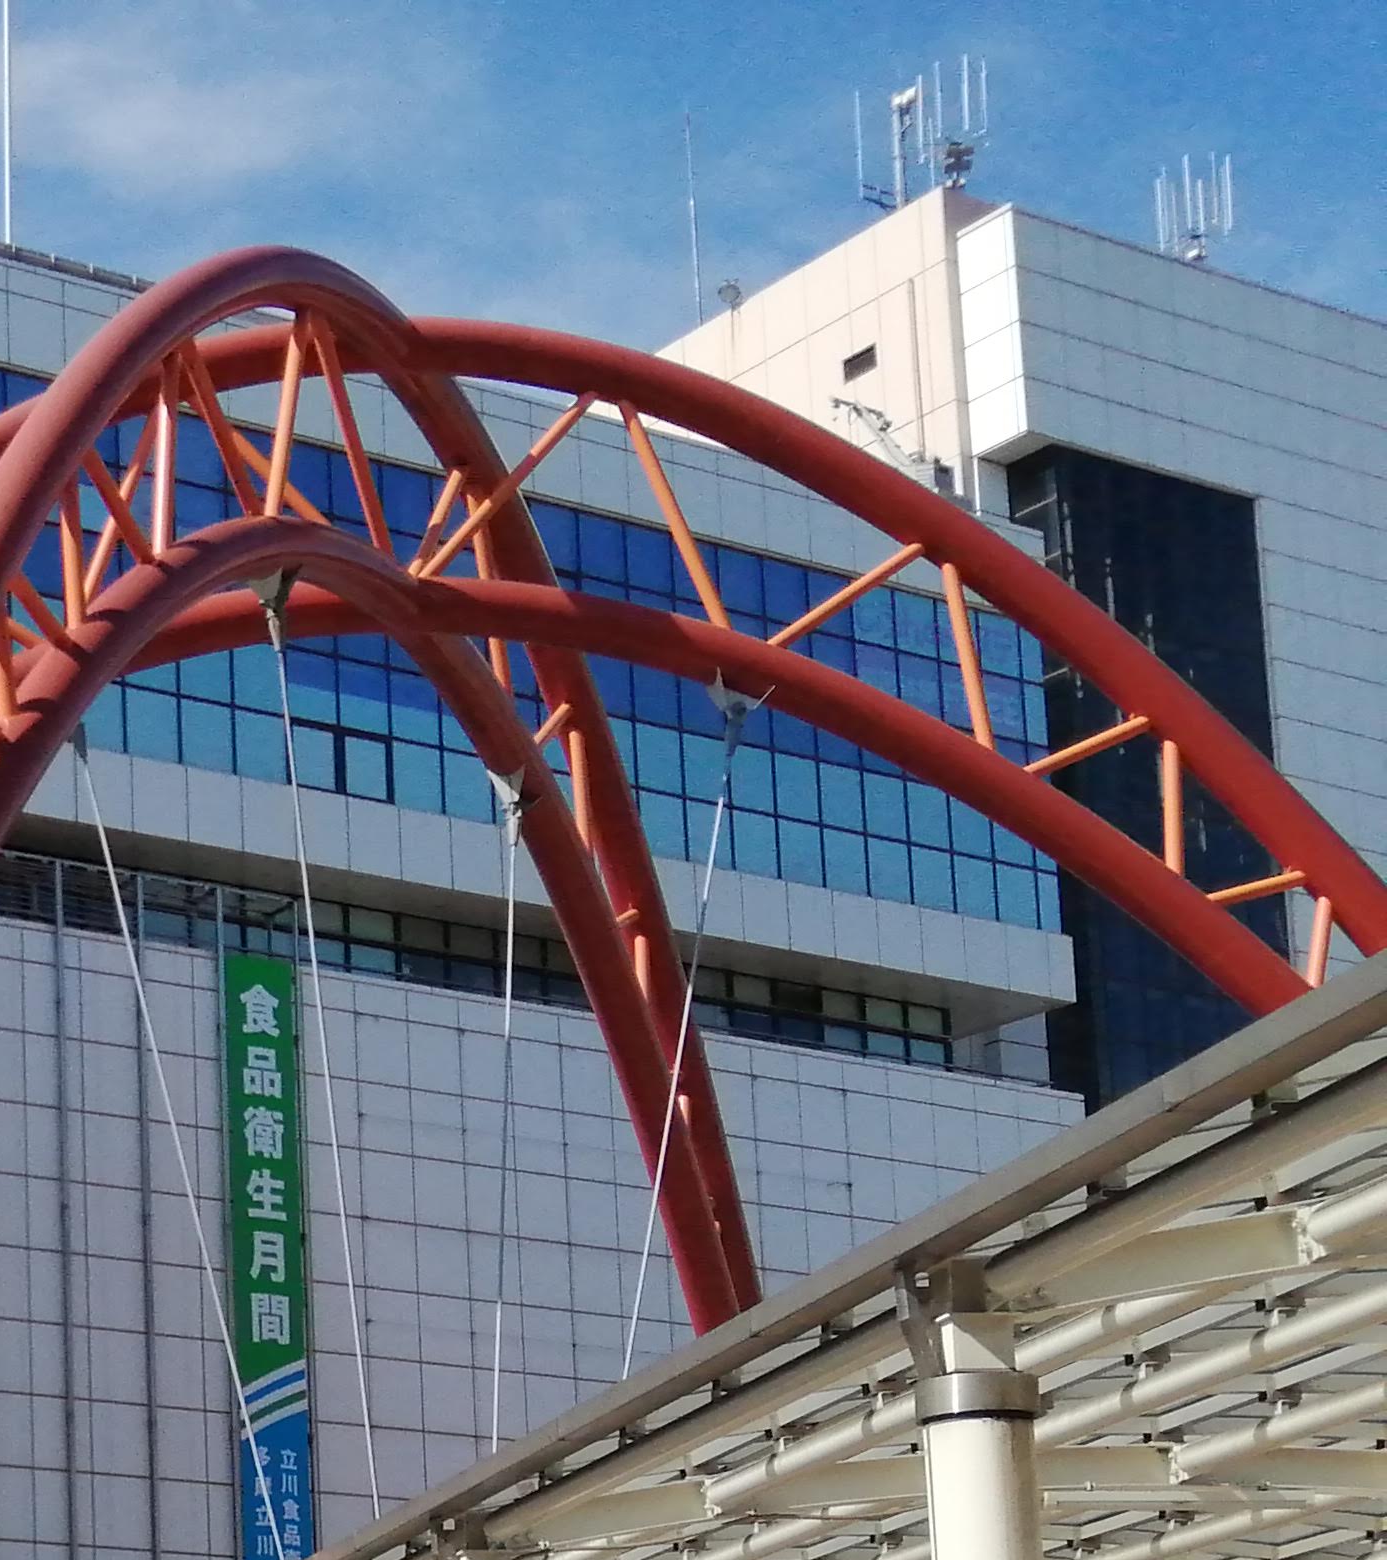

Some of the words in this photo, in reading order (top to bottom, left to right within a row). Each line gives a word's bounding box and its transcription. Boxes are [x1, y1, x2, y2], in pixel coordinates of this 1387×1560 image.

[239, 983, 292, 1347] 食品衛生月間
